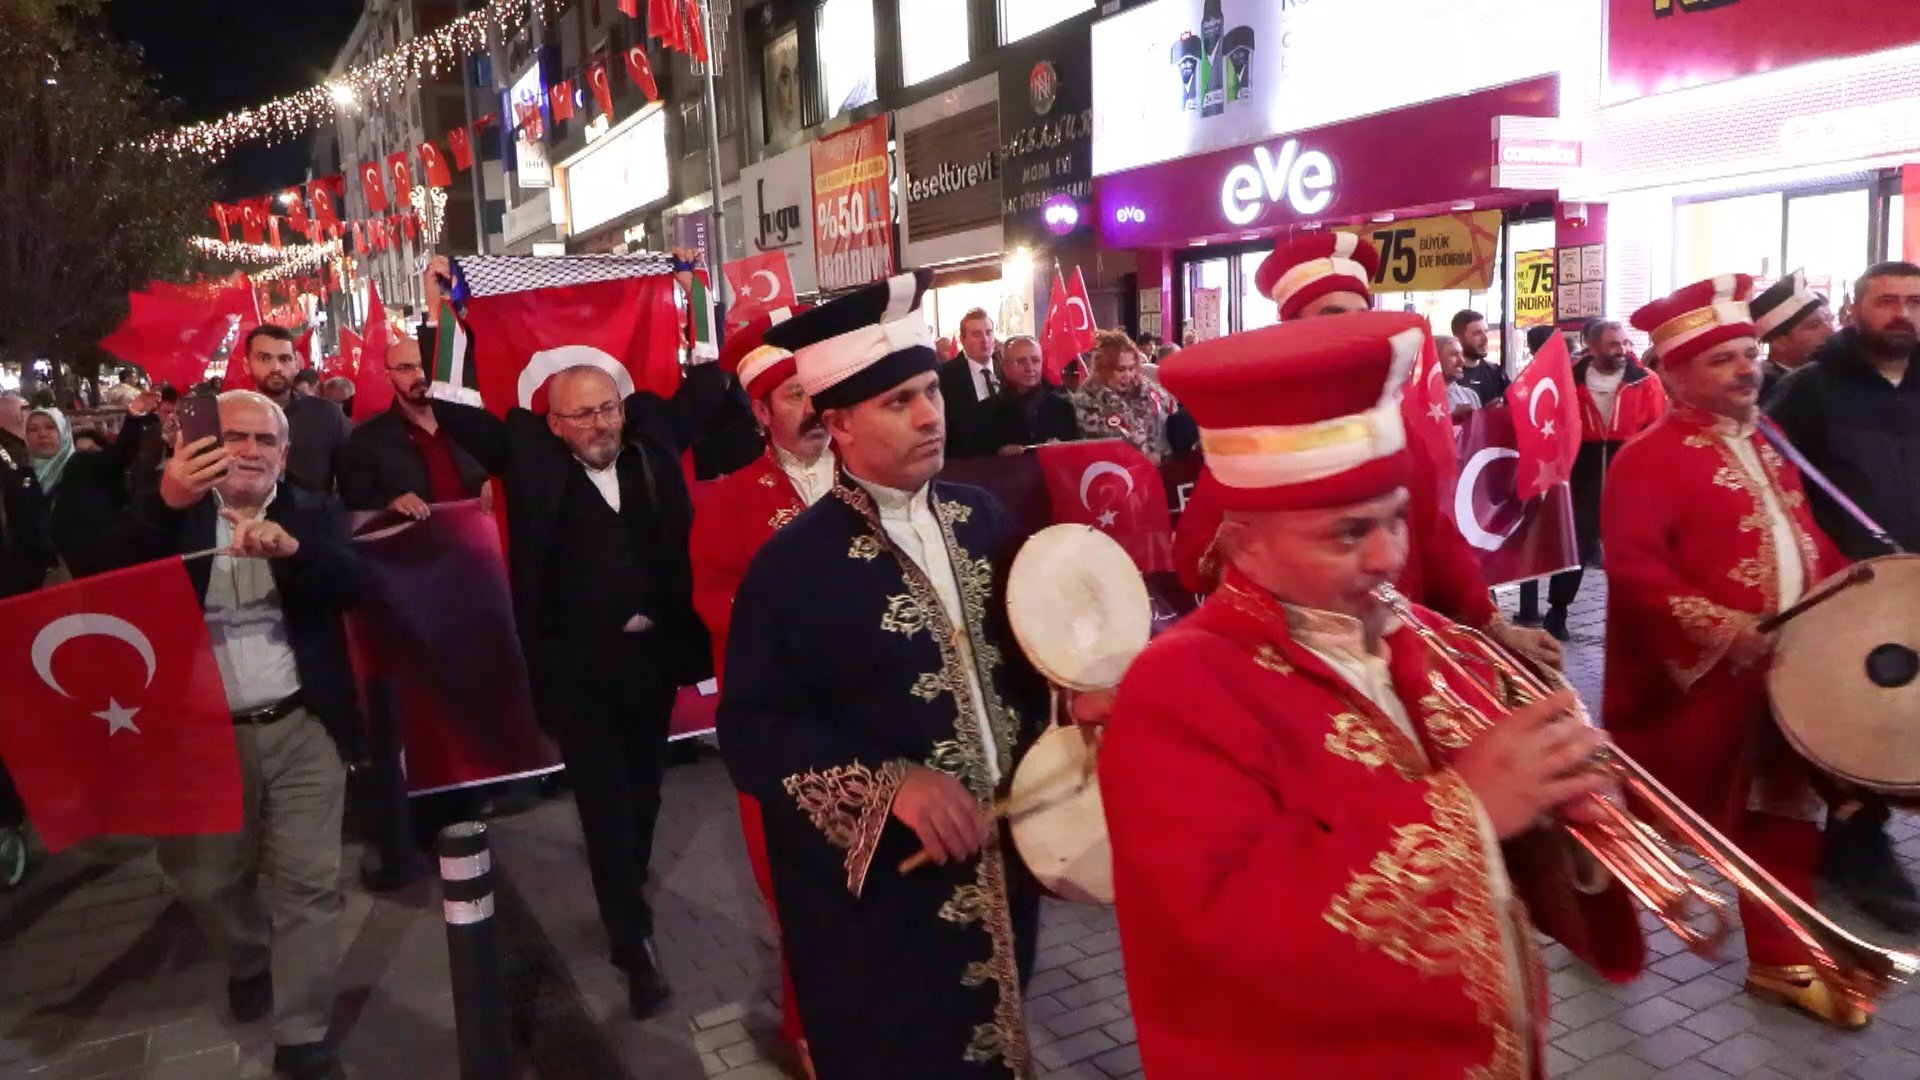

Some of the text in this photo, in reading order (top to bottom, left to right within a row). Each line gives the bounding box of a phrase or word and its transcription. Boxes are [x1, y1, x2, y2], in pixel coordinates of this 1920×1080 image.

[905, 152, 992, 201] tesettürevi
[1023, 162, 1051, 184] MODA
[1222, 139, 1335, 225] eve
[818, 190, 864, 240] %50
[1117, 206, 1146, 223] eve
[1373, 228, 1417, 284] 75
[1420, 234, 1450, 250] BÜYÜK
[1419, 255, 1434, 268] EVE
[1528, 263, 1554, 294] 75
